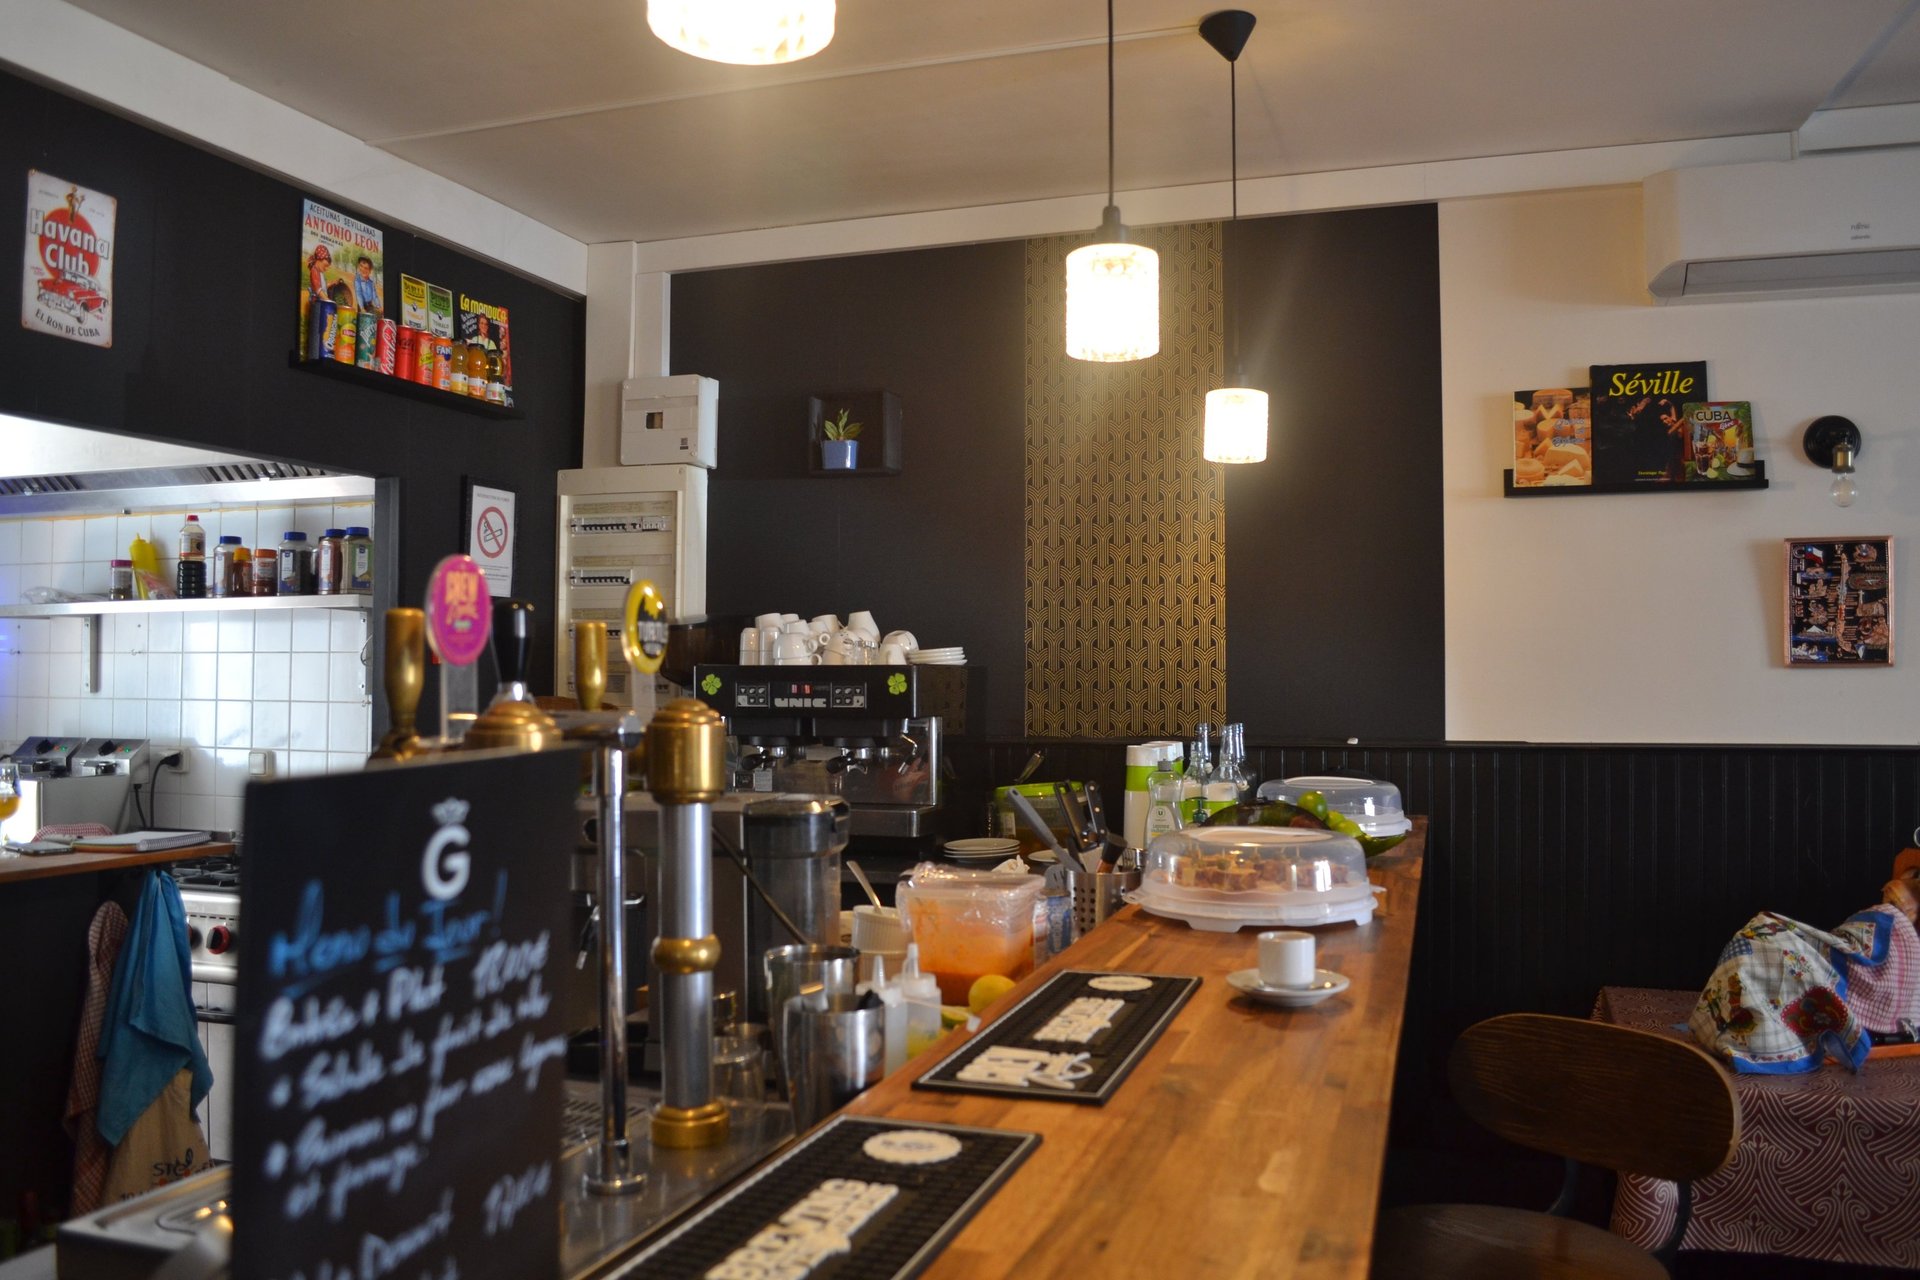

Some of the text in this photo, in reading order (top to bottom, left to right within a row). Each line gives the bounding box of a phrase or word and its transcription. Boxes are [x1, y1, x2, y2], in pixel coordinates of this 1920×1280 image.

[30, 208, 109, 260] Havana
[305, 213, 352, 242] ANTONIO
[310, 204, 377, 237] ACEITUNAS SEVILLANAS
[45, 243, 91, 277] Club
[35, 308, 100, 337] EL RON DE CUBA
[1609, 370, 1694, 396] Séville
[1696, 410, 1733, 422] CUBA
[774, 697, 827, 708] UNIC
[422, 824, 472, 900] G
